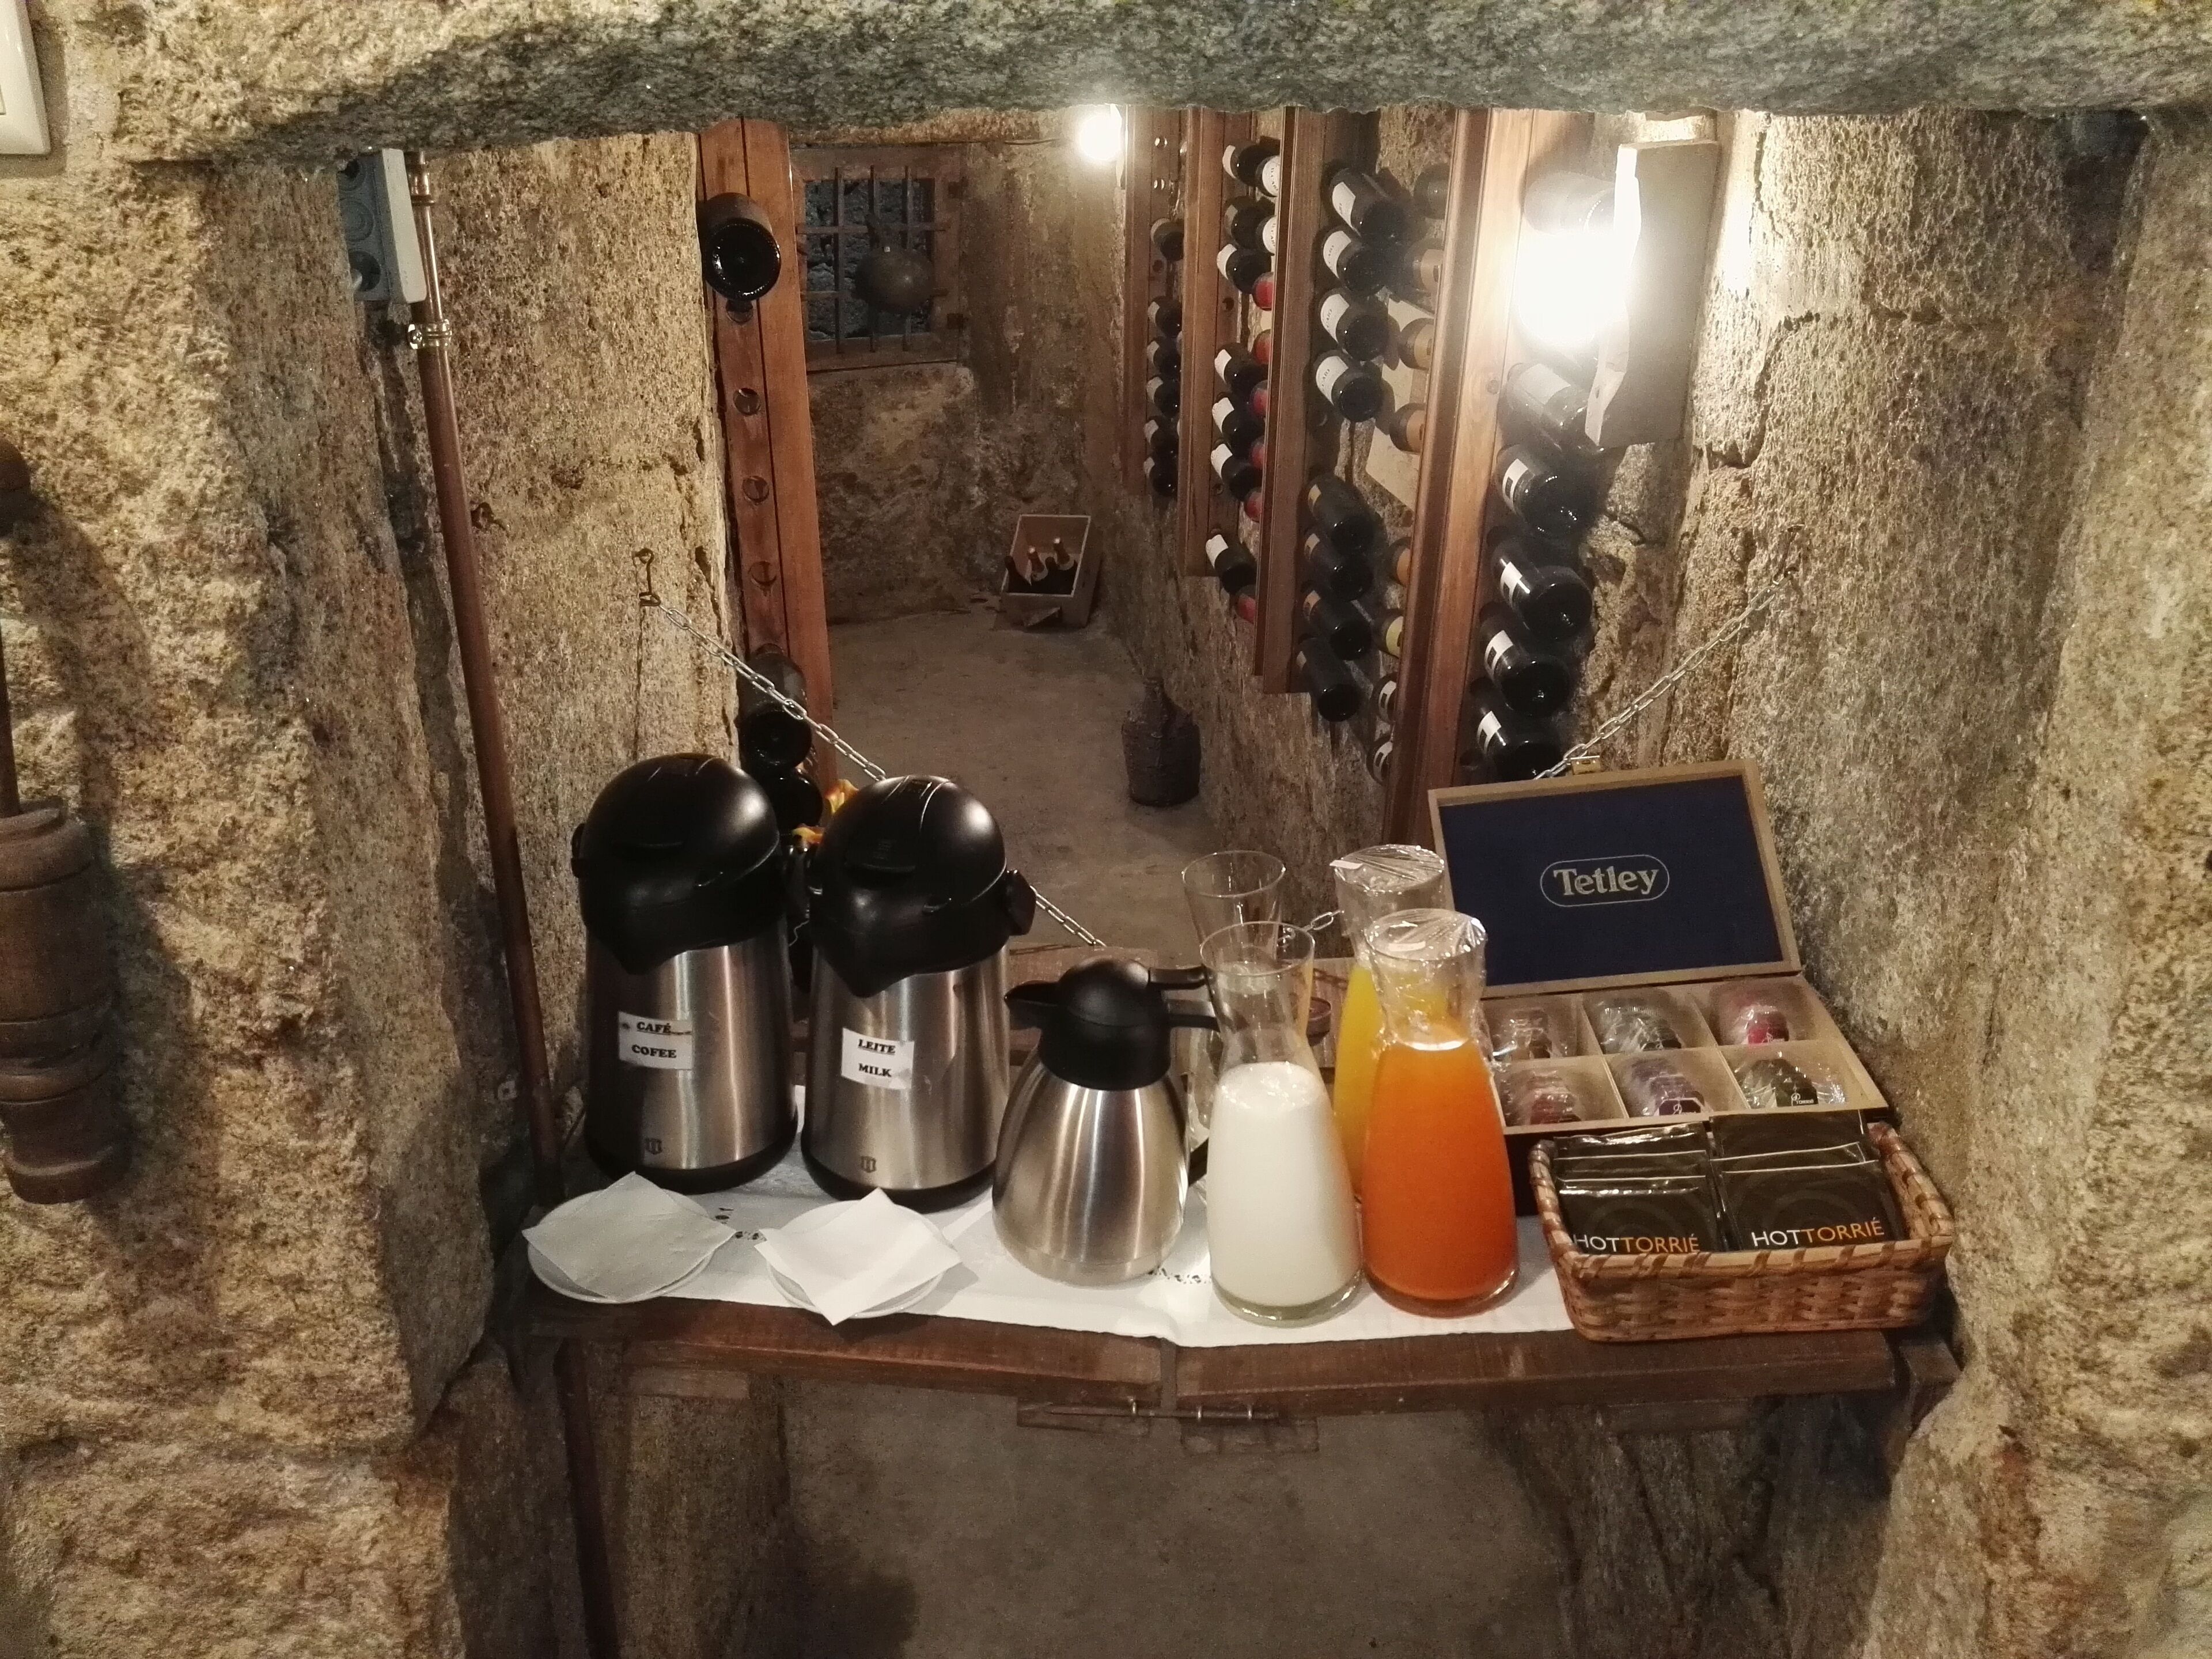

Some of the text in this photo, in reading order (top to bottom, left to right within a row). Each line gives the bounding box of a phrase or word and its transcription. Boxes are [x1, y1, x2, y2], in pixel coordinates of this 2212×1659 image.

[1553, 866, 1659, 895] Tetley
[637, 1021, 671, 1034] CAFÉ
[631, 1044, 677, 1058] COFEE
[858, 1039, 896, 1054] LEITE
[858, 1063, 892, 1077] MILK
